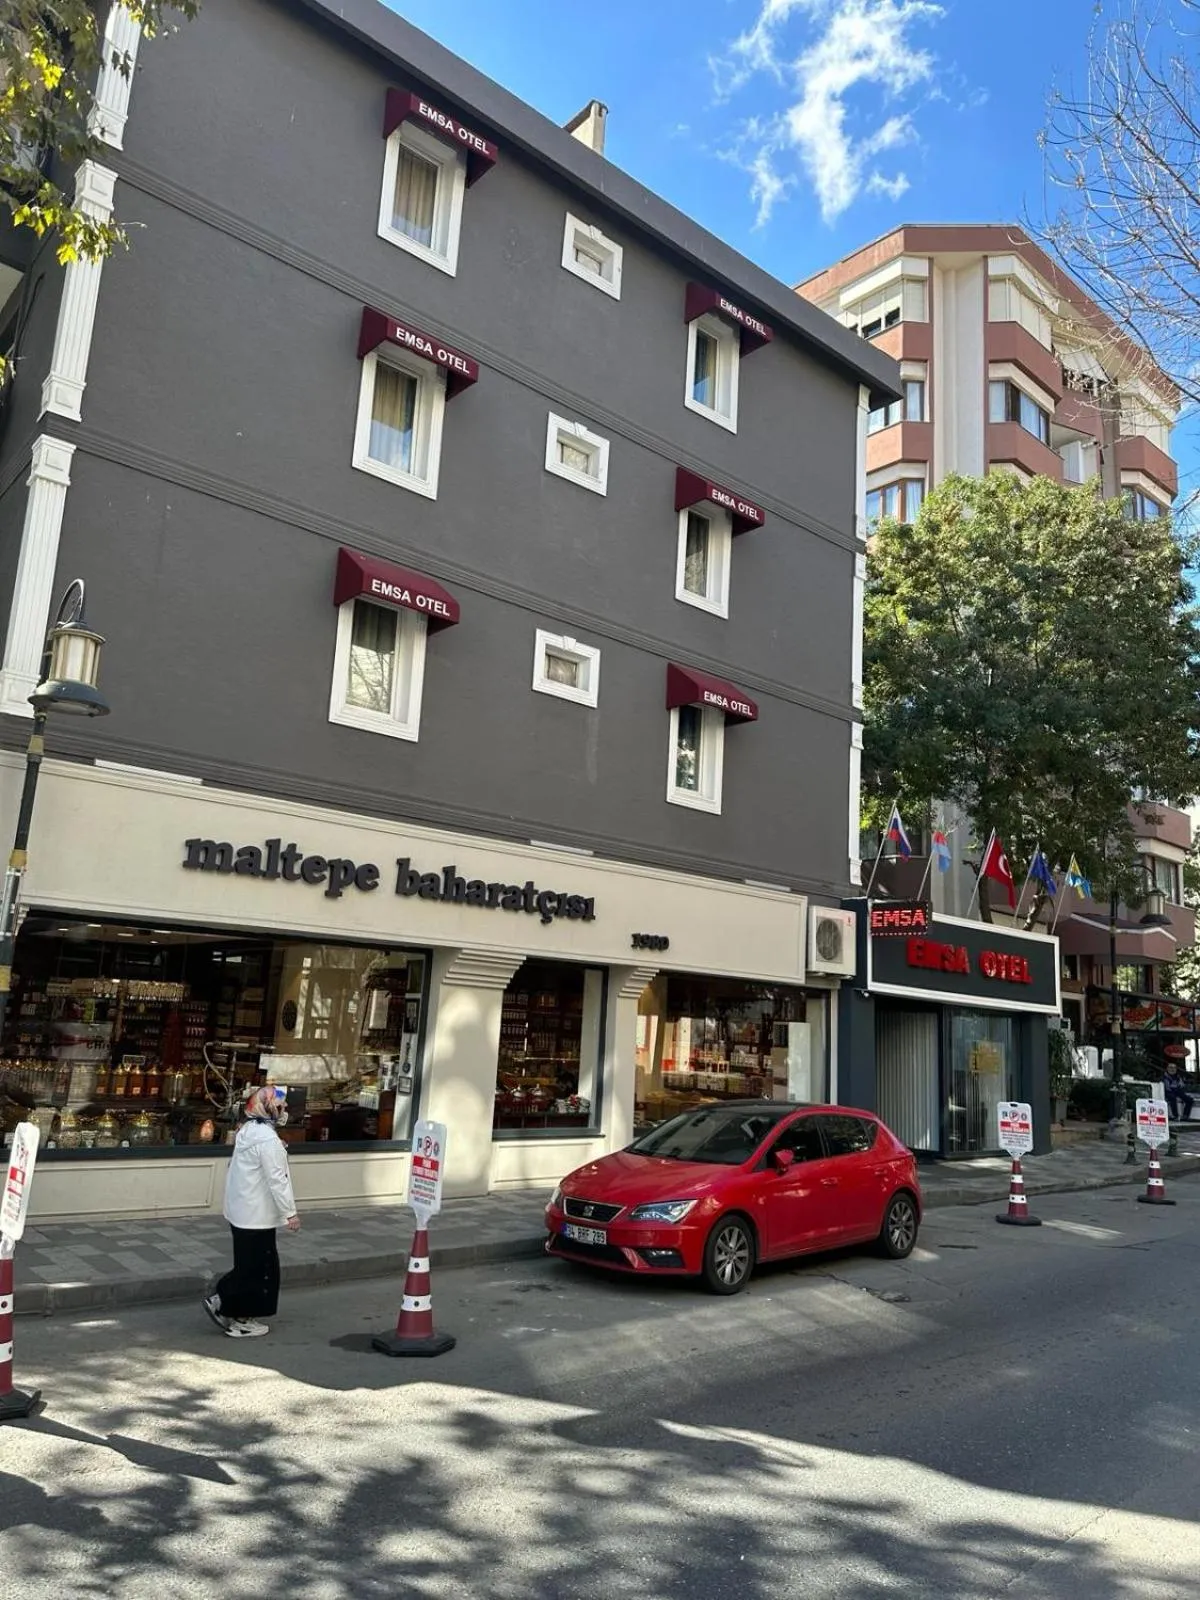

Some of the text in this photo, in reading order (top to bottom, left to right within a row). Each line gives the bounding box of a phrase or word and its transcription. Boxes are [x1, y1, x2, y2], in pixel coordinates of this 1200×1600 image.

[418, 102, 490, 155] EMSA OTEL
[720, 298, 767, 336] EMSA OTEL
[396, 327, 470, 374] EMSA OTEL
[711, 488, 760, 521] EMSA OTEL
[371, 578, 450, 617] EMSA OTEL
[703, 690, 753, 716] EMSA OTEL
[183, 838, 596, 926] maltepe baharatçısı
[871, 908, 926, 928] EMSA
[907, 938, 1033, 985] EMSA OTEL
